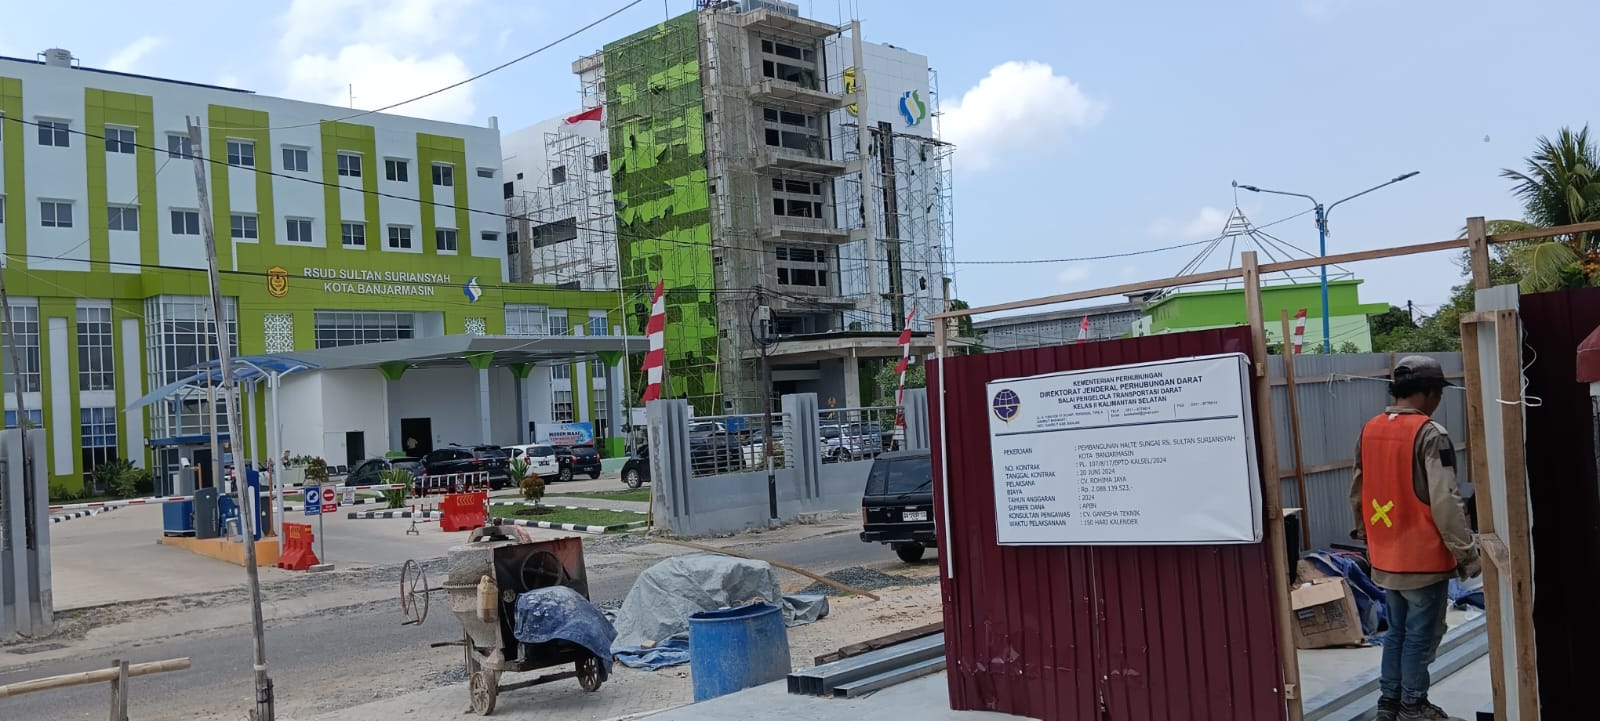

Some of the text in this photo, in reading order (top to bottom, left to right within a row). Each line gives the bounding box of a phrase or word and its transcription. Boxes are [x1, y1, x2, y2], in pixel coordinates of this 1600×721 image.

[304, 267, 450, 283] RSUD SULTAN SURIANSYAH
[324, 282, 434, 296] KOTA BANJARMASIN
[1073, 372, 1162, 386] KEMENTERIAN PERHUBUNGAN
[1040, 376, 1202, 398] DIREKTORAT JENDERAL PERHUBUNGAN DARAT
[1076, 394, 1112, 402] PENGELOLA
[1113, 388, 1160, 399] TRANSPORTASI
[1160, 386, 1182, 394] DARAT
[1098, 399, 1137, 408] KALIMANTAN
[1138, 396, 1167, 404] SELATAN
[1078, 443, 1119, 451] PEMBANGUNAN
